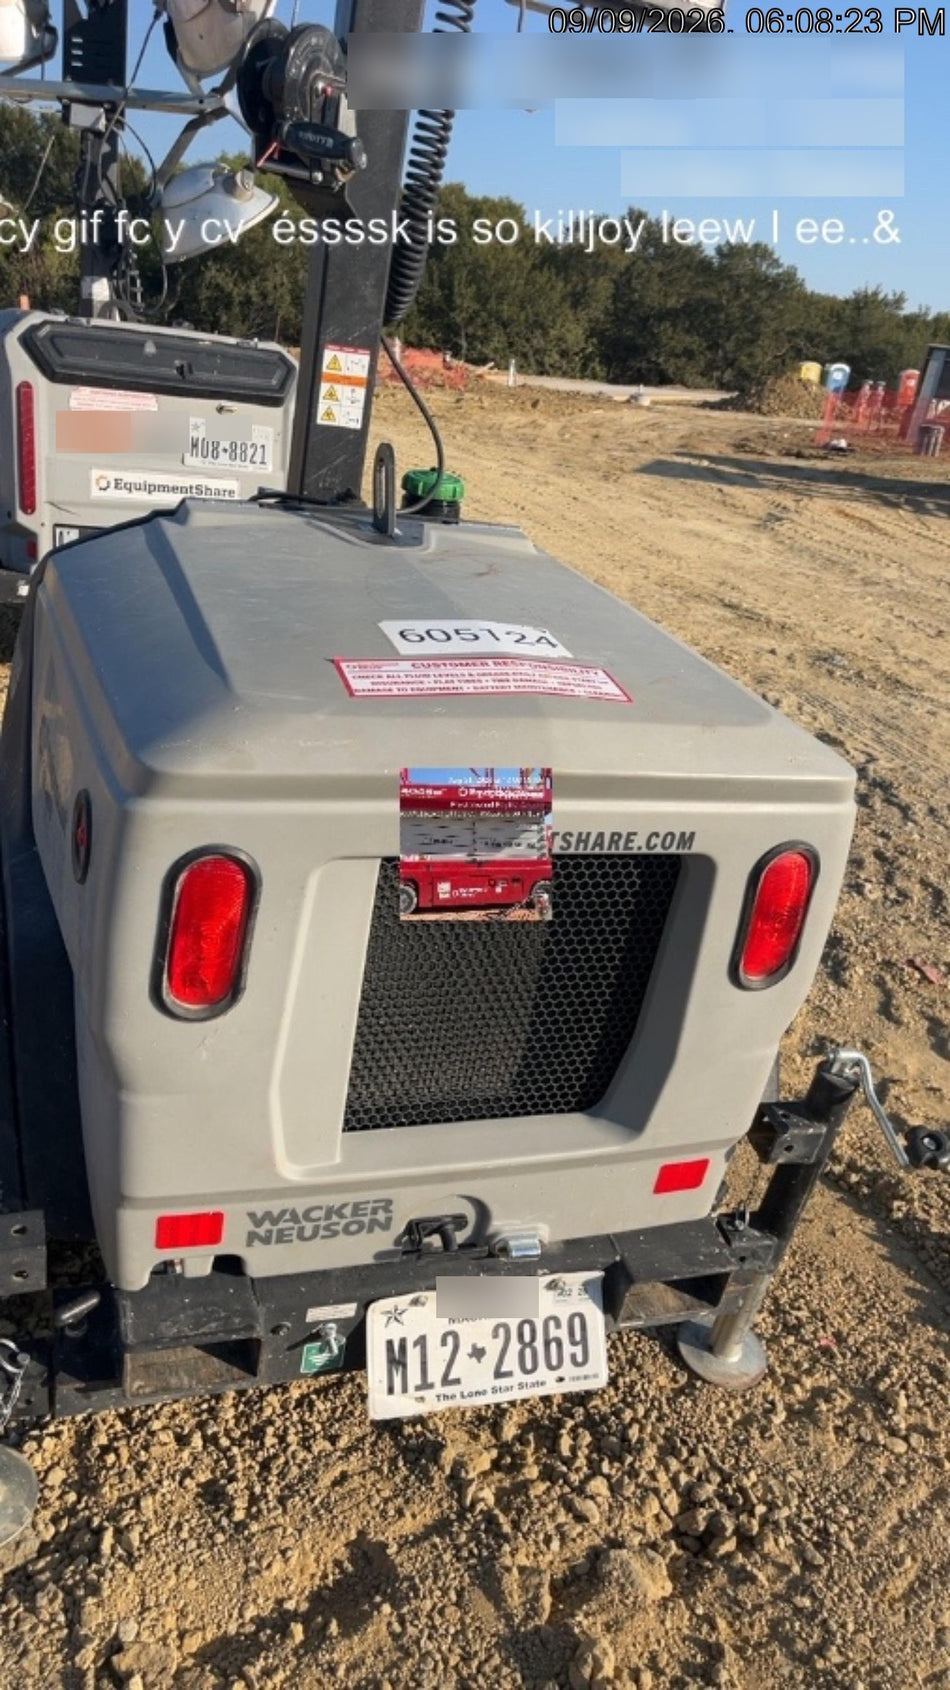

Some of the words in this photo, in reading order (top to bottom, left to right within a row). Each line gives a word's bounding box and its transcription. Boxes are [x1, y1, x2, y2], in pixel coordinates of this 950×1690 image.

[113, 477, 236, 498] EquipmentShare
[246, 1198, 394, 1229] WACKER
[245, 1216, 393, 1248] NEUSON
[491, 1311, 590, 1381] 2869
[435, 1392, 457, 1402] The
[459, 1389, 488, 1401] Lone
[491, 1385, 514, 1396] Star
[517, 1380, 547, 1392] State
